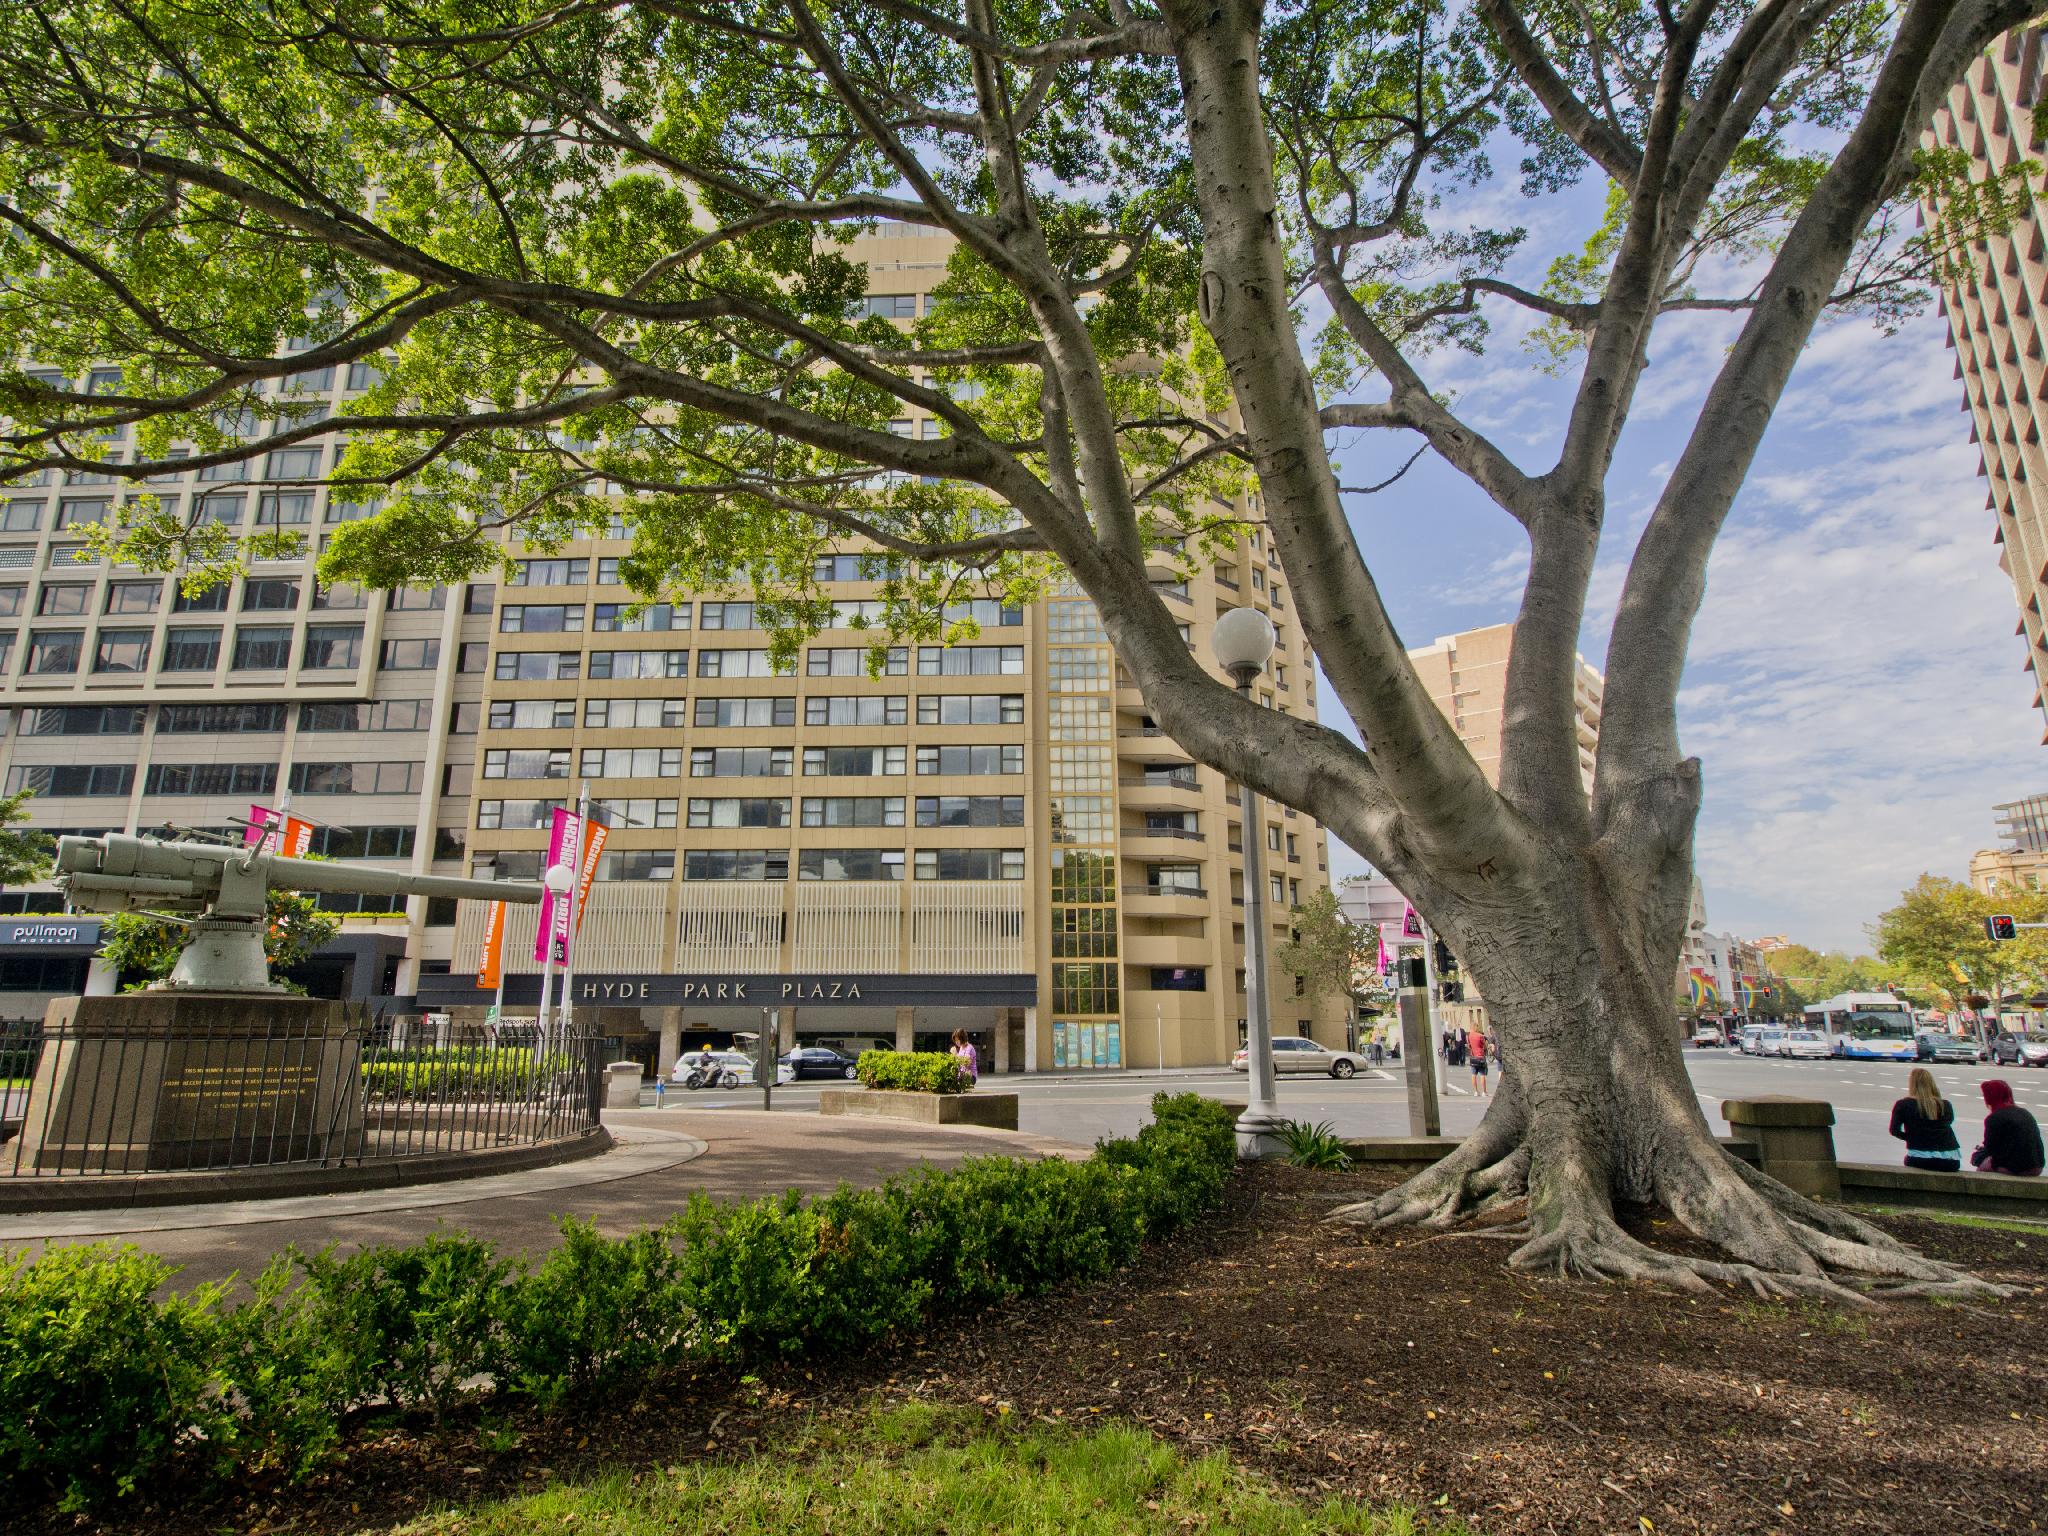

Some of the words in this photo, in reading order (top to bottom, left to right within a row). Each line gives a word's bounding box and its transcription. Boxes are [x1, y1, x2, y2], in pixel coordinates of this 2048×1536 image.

[13, 924, 77, 940] pullman
[583, 983, 649, 998] HYDE
[684, 983, 746, 998] PARK
[782, 983, 861, 998] PLAZA
